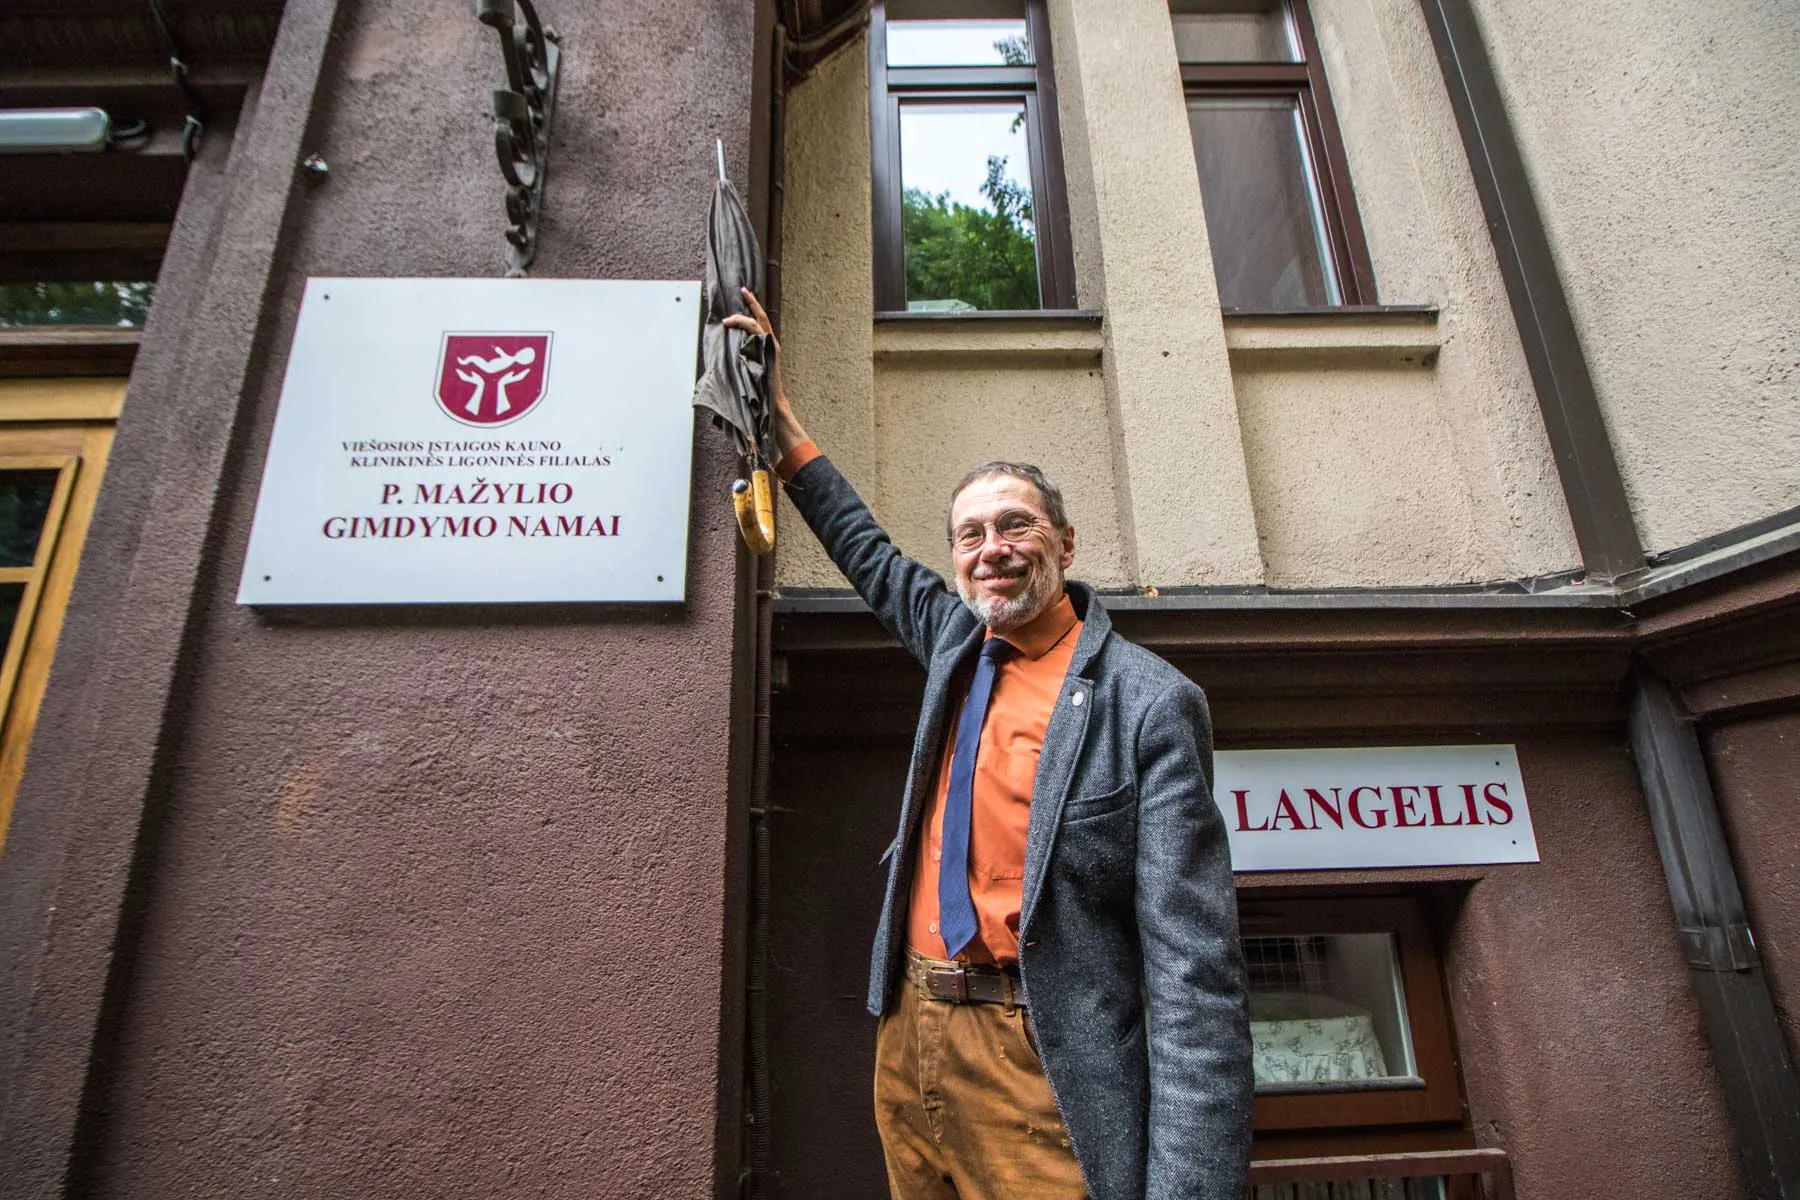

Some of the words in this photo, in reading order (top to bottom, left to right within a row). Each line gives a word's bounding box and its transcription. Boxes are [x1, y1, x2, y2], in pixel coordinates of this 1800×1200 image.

[341, 439, 424, 452] VIEŠOSIOS
[427, 441, 501, 456] ĮSTAIGOS
[504, 440, 562, 452] KAUNO
[350, 455, 445, 467] KLINIKINĖS
[448, 454, 535, 467] LIGONINĖS
[538, 455, 612, 467] FILIALAS
[379, 483, 404, 505] P.
[413, 477, 574, 504] MAŽYLIO
[322, 515, 498, 539] GIMDYMO
[505, 515, 622, 538] NAMAI
[1230, 781, 1514, 833] LANGELIS
